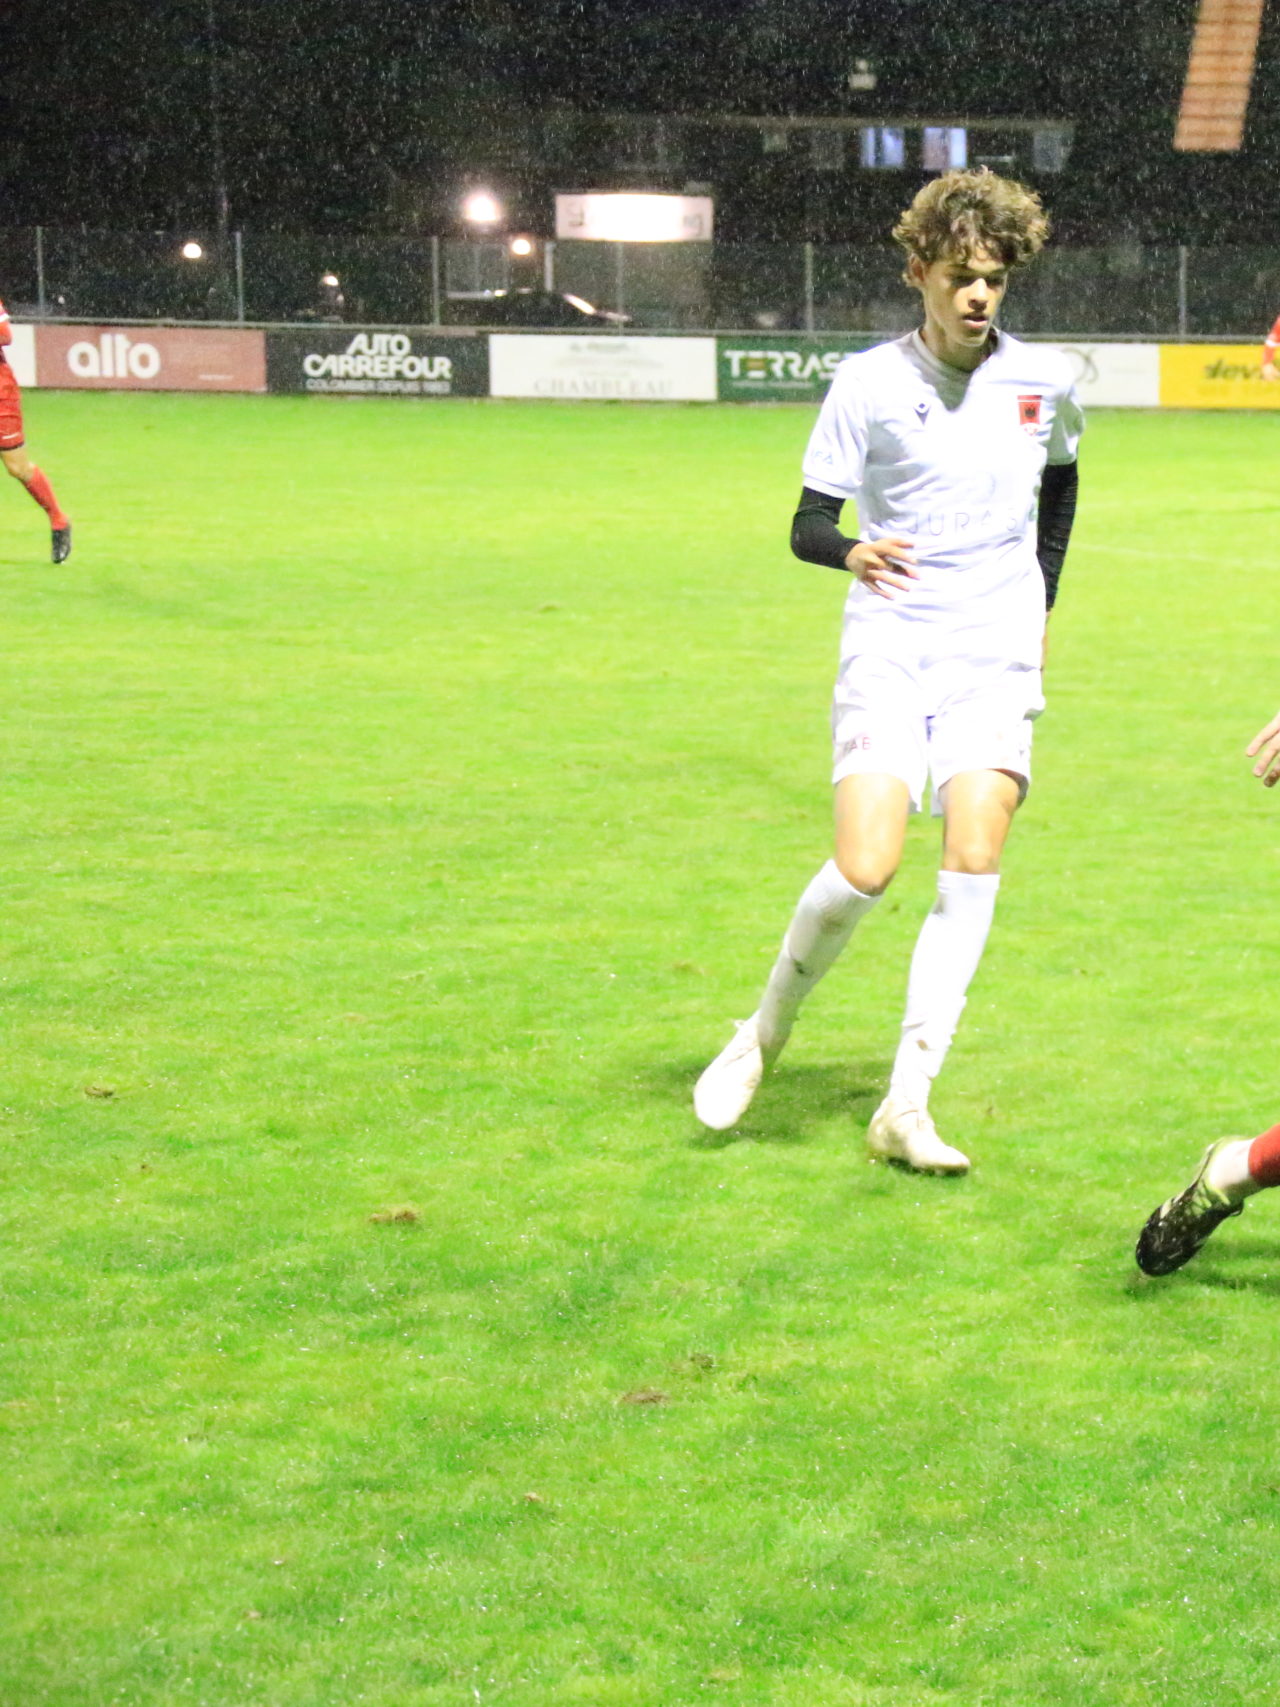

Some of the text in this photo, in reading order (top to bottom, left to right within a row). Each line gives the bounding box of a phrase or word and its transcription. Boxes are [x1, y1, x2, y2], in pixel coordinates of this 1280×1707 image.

[67, 332, 161, 379] alto
[346, 333, 411, 355] AUTO
[303, 354, 453, 379] CARREFOUR
[724, 350, 842, 380] TERRAS
[533, 377, 674, 396] CHAMBLEAU
